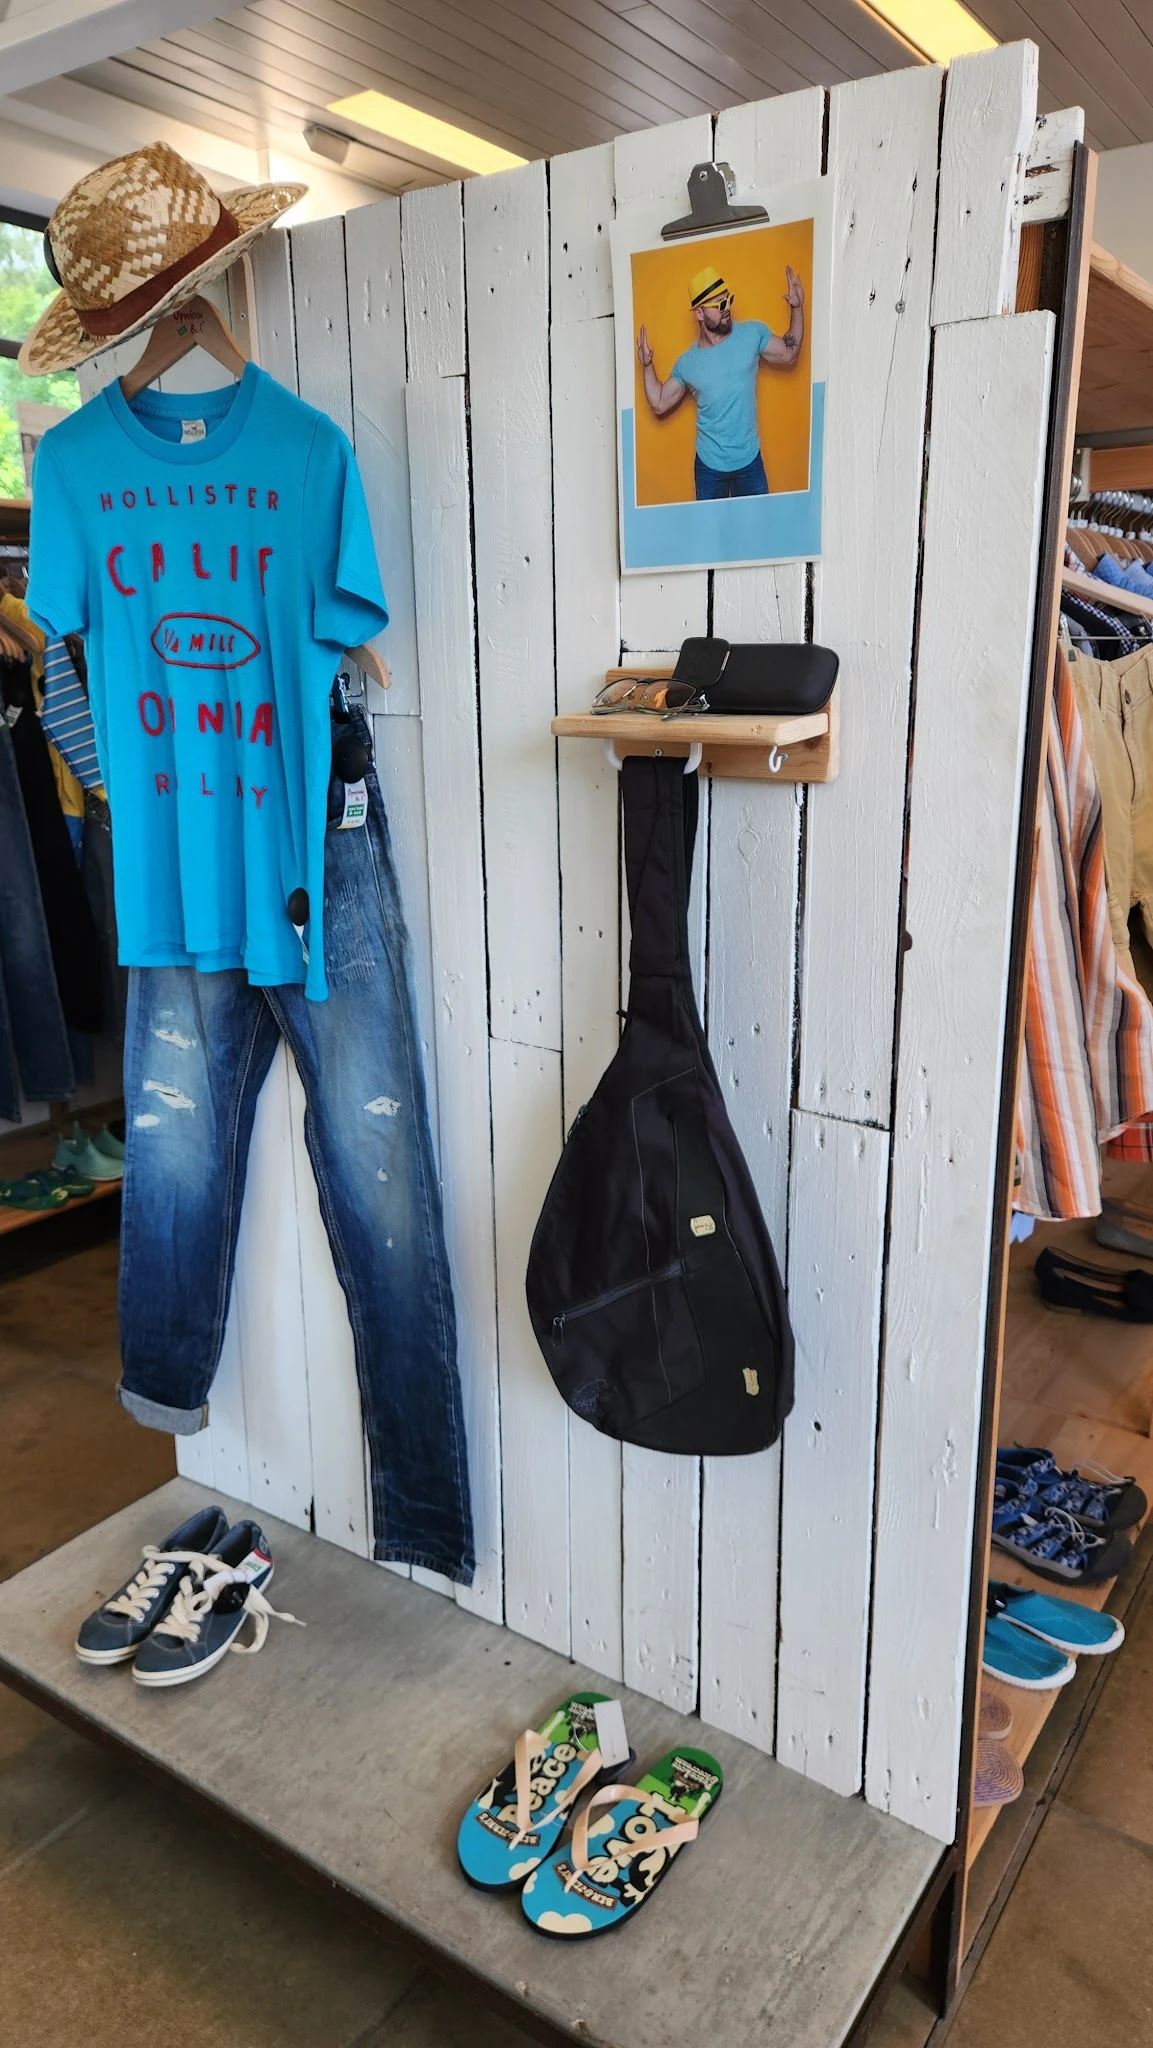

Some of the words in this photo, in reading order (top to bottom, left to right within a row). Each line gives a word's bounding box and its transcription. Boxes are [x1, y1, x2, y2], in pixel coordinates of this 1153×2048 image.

[100, 483, 278, 512] HOLLISTER
[107, 541, 273, 598] CALIF
[138, 690, 273, 746] ONIA
[496, 1743, 577, 1829] Peace
[586, 1791, 692, 1883] Love
